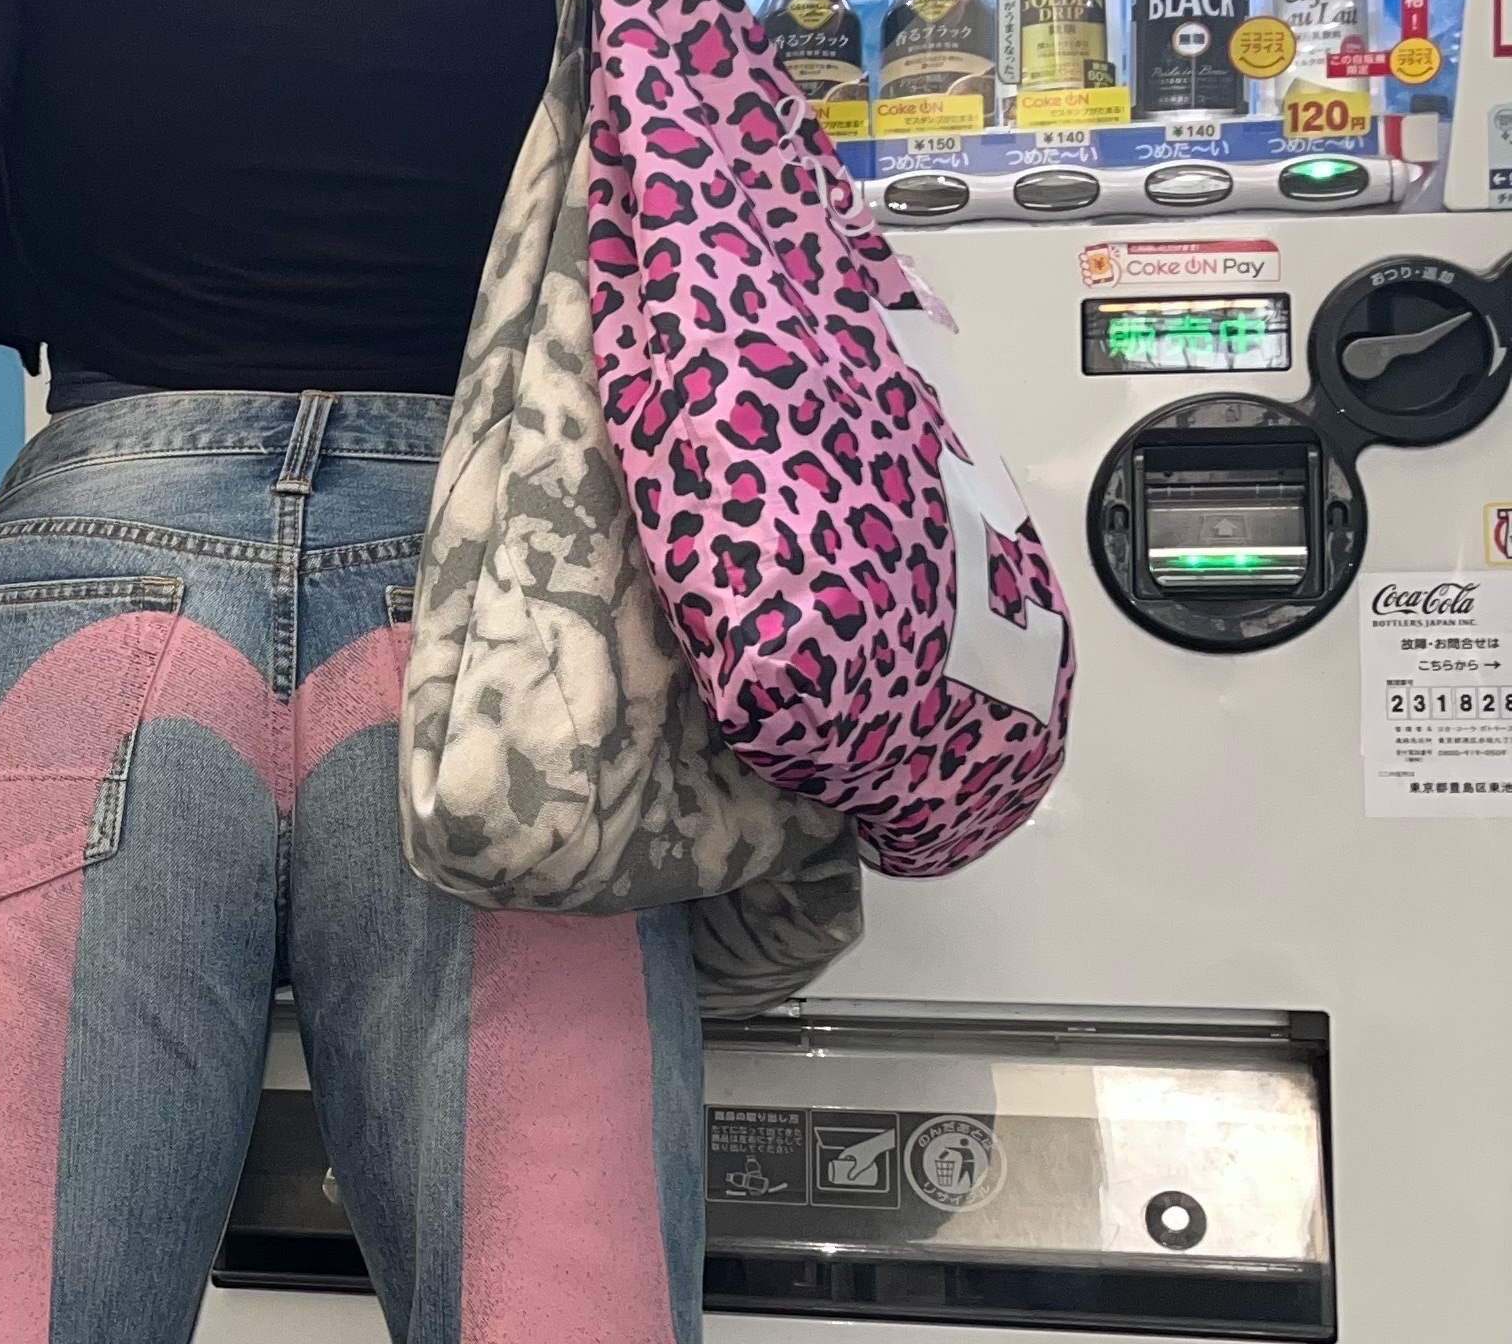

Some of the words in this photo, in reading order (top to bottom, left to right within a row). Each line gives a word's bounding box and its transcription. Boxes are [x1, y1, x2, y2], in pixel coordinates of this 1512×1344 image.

[1038, 7, 1084, 20] DRIP
[1241, 32, 1285, 42] ニコニコ
[1241, 42, 1285, 54] プライス
[1287, 101, 1366, 132] 120円
[1126, 258, 1180, 276] Coke
[1185, 253, 1218, 275] ON
[1223, 257, 1265, 278] Pay
[1369, 267, 1455, 286] おつり・返却
[1108, 313, 1267, 356] 販売中
[1372, 582, 1481, 615] Coca-Cola
[1372, 619, 1423, 628] BOTTLERS
[1425, 619, 1456, 628] JAPAN
[1401, 638, 1499, 650] 故障・お問合せは
[1418, 660, 1479, 671] こちらから
